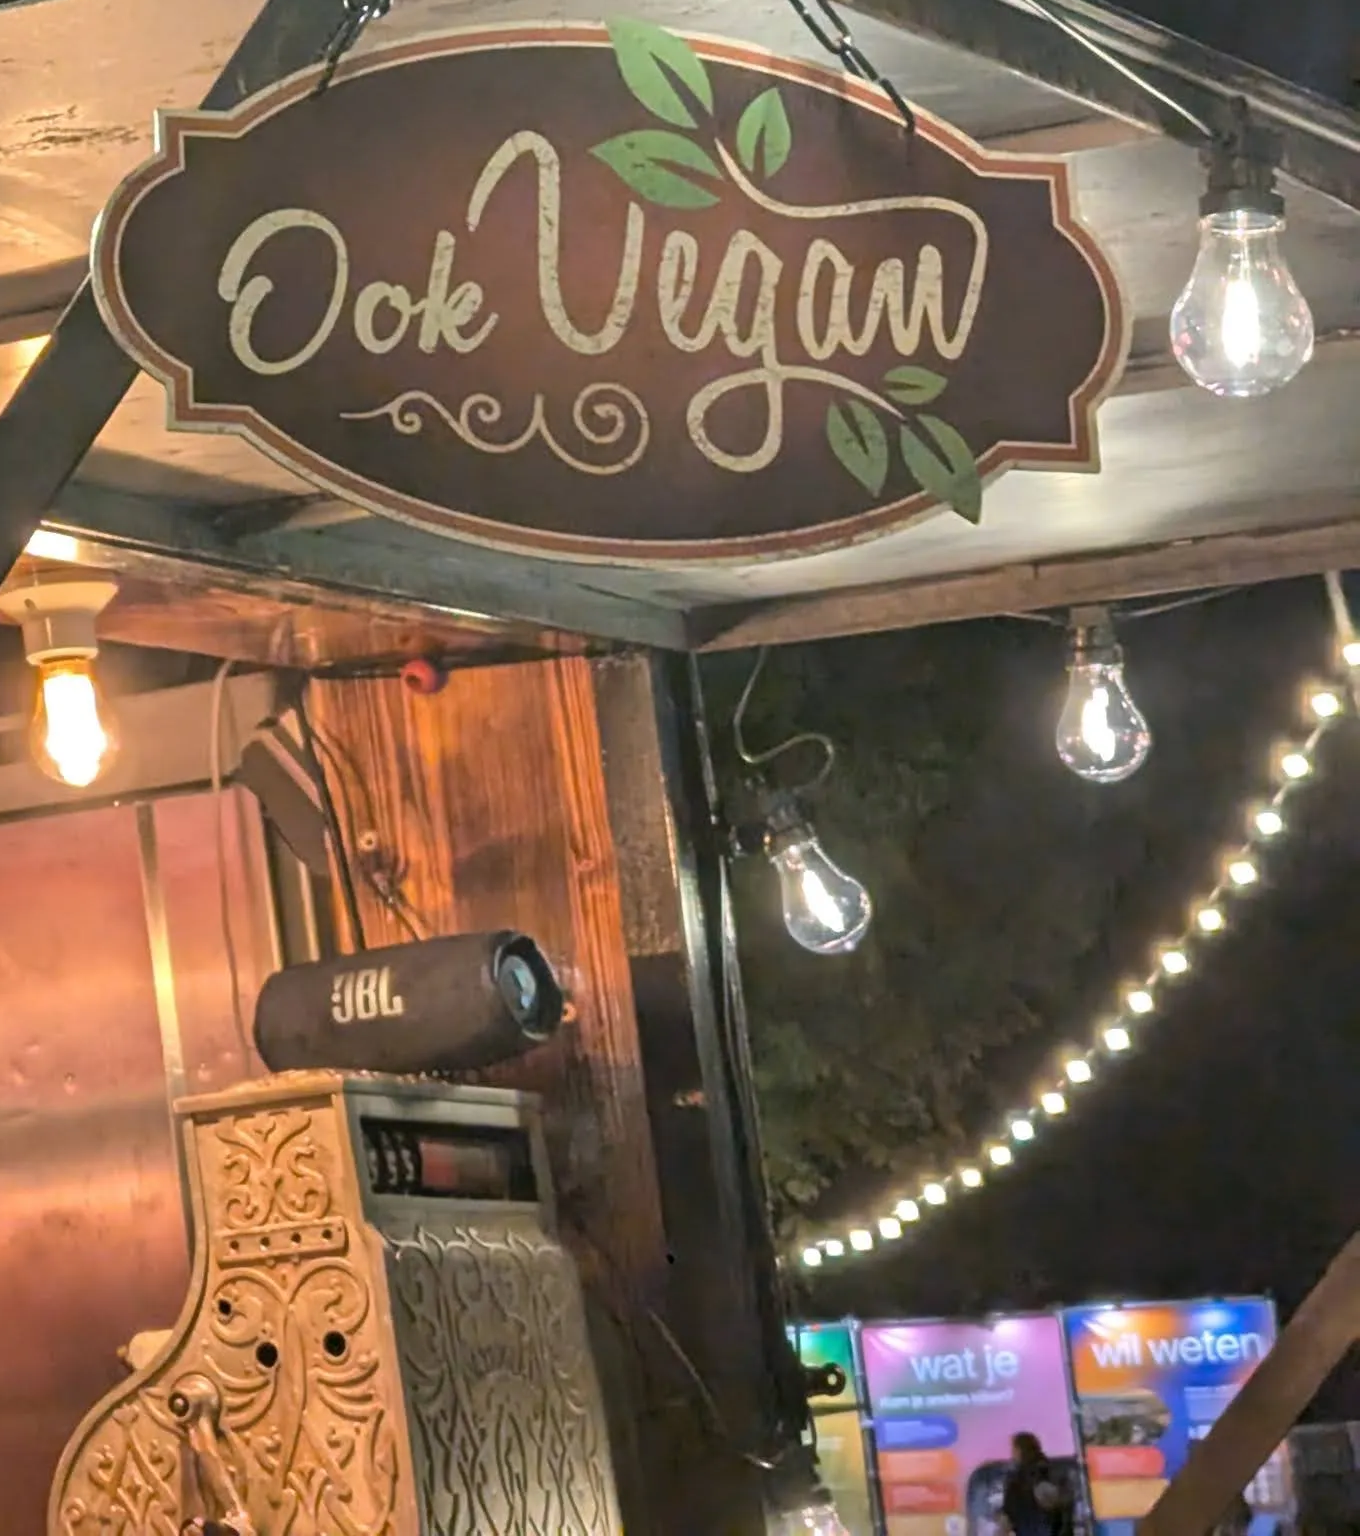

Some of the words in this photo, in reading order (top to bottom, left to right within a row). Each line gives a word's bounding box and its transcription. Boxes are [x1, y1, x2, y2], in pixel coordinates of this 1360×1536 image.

[217, 206, 498, 376] Ook
[467, 128, 990, 474] Vegan
[331, 966, 404, 1024] JBL
[909, 1347, 977, 1383] wat
[983, 1343, 1020, 1386] je
[1091, 1331, 1143, 1368] wil
[1148, 1329, 1263, 1364] weten
